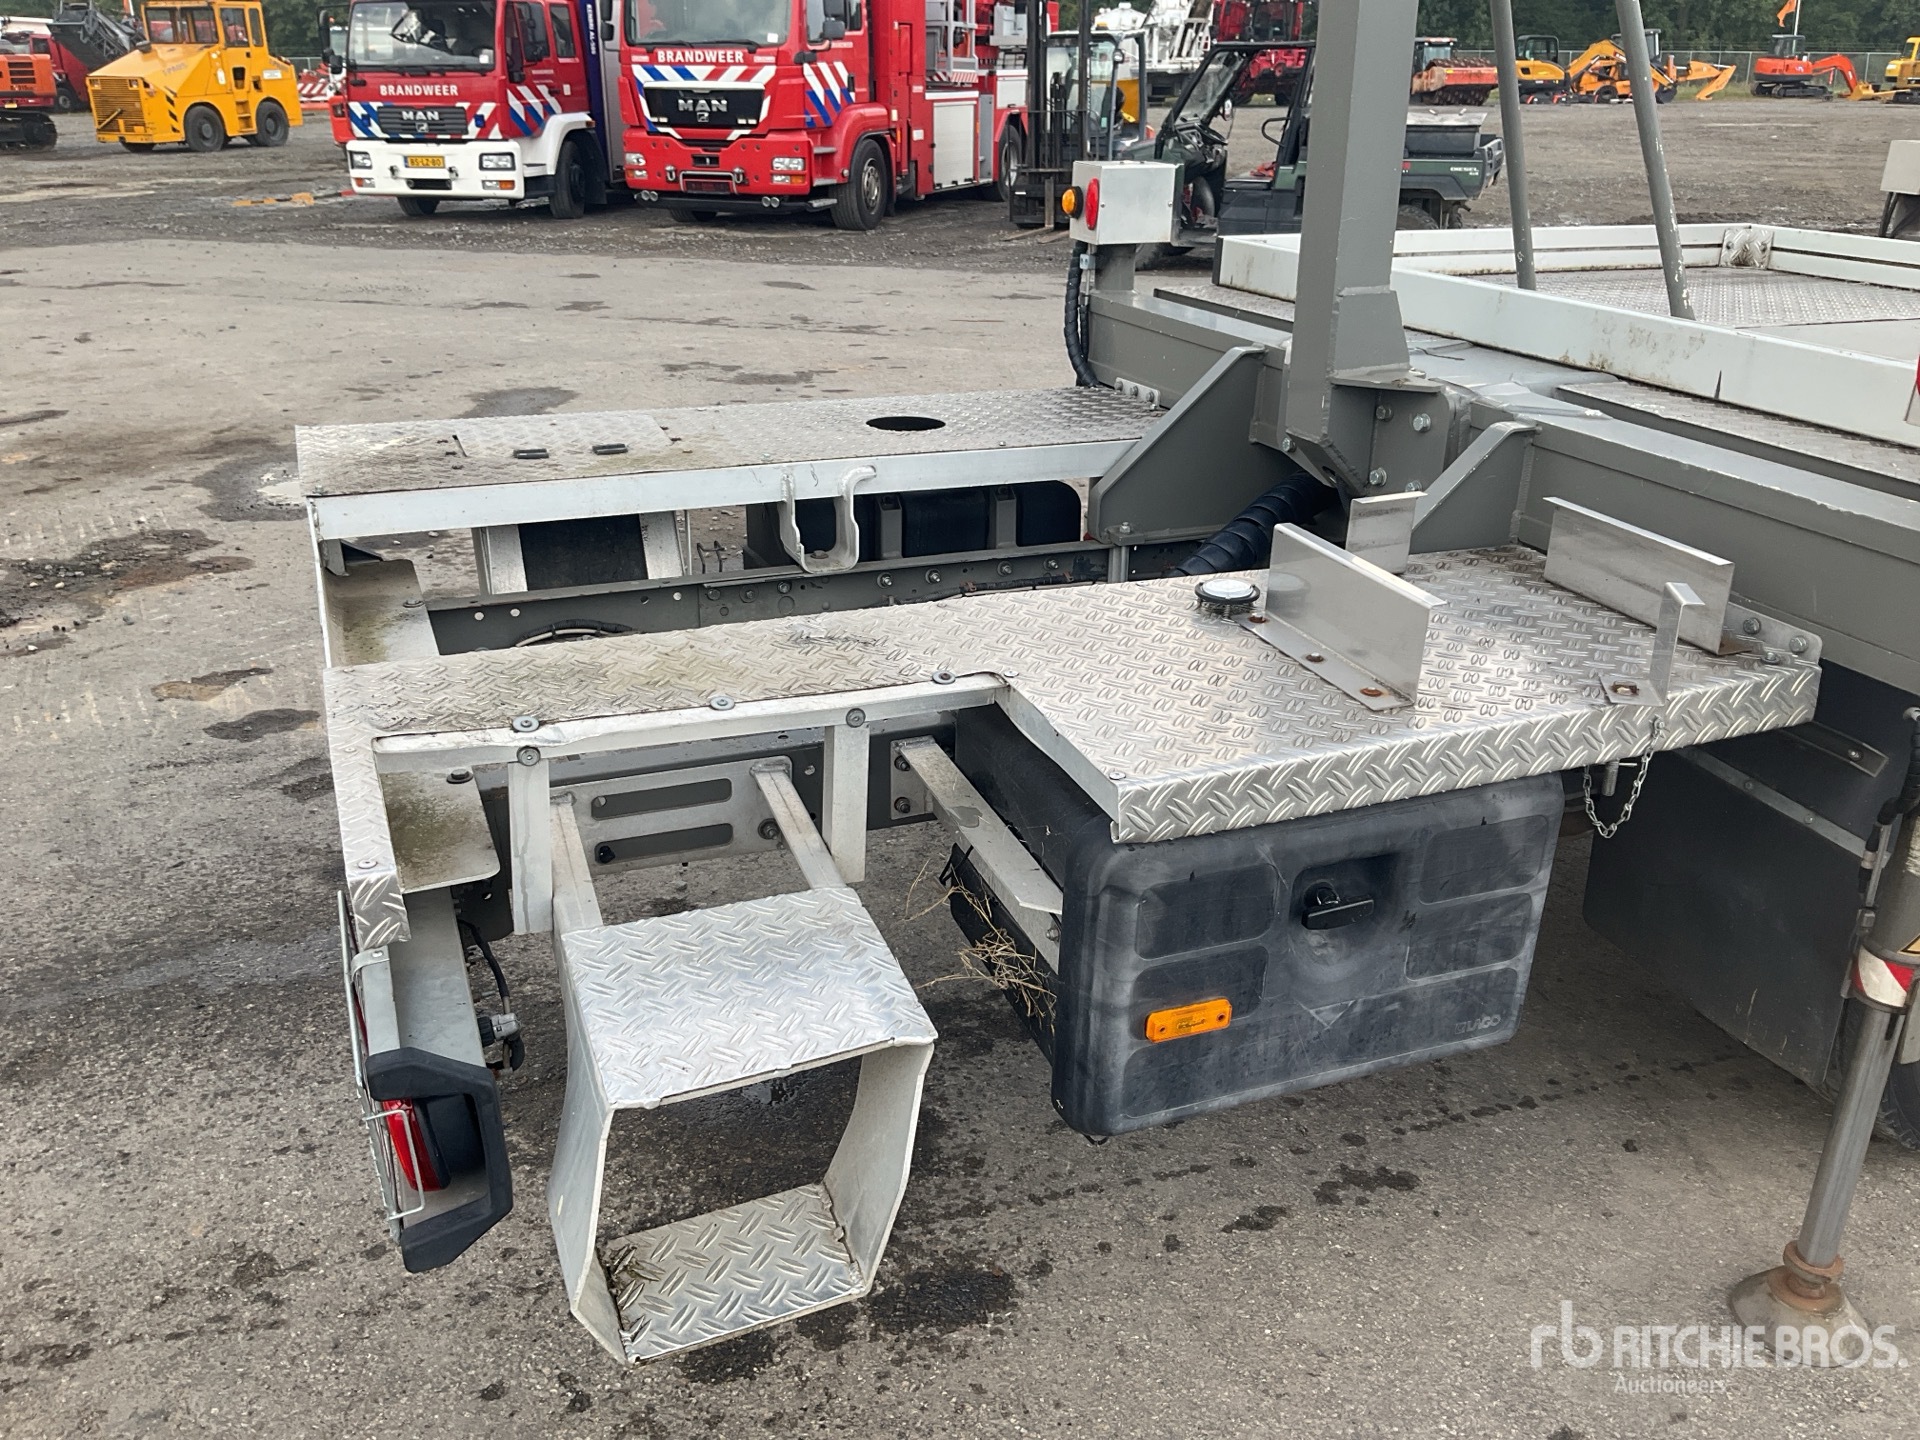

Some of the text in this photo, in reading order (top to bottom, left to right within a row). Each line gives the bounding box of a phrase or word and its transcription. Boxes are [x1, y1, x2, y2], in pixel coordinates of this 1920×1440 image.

[657, 50, 744, 63] BRANDWEER
[380, 84, 458, 96] BRANDWEER
[677, 99, 728, 112] MAN
[402, 110, 440, 121] MAN
